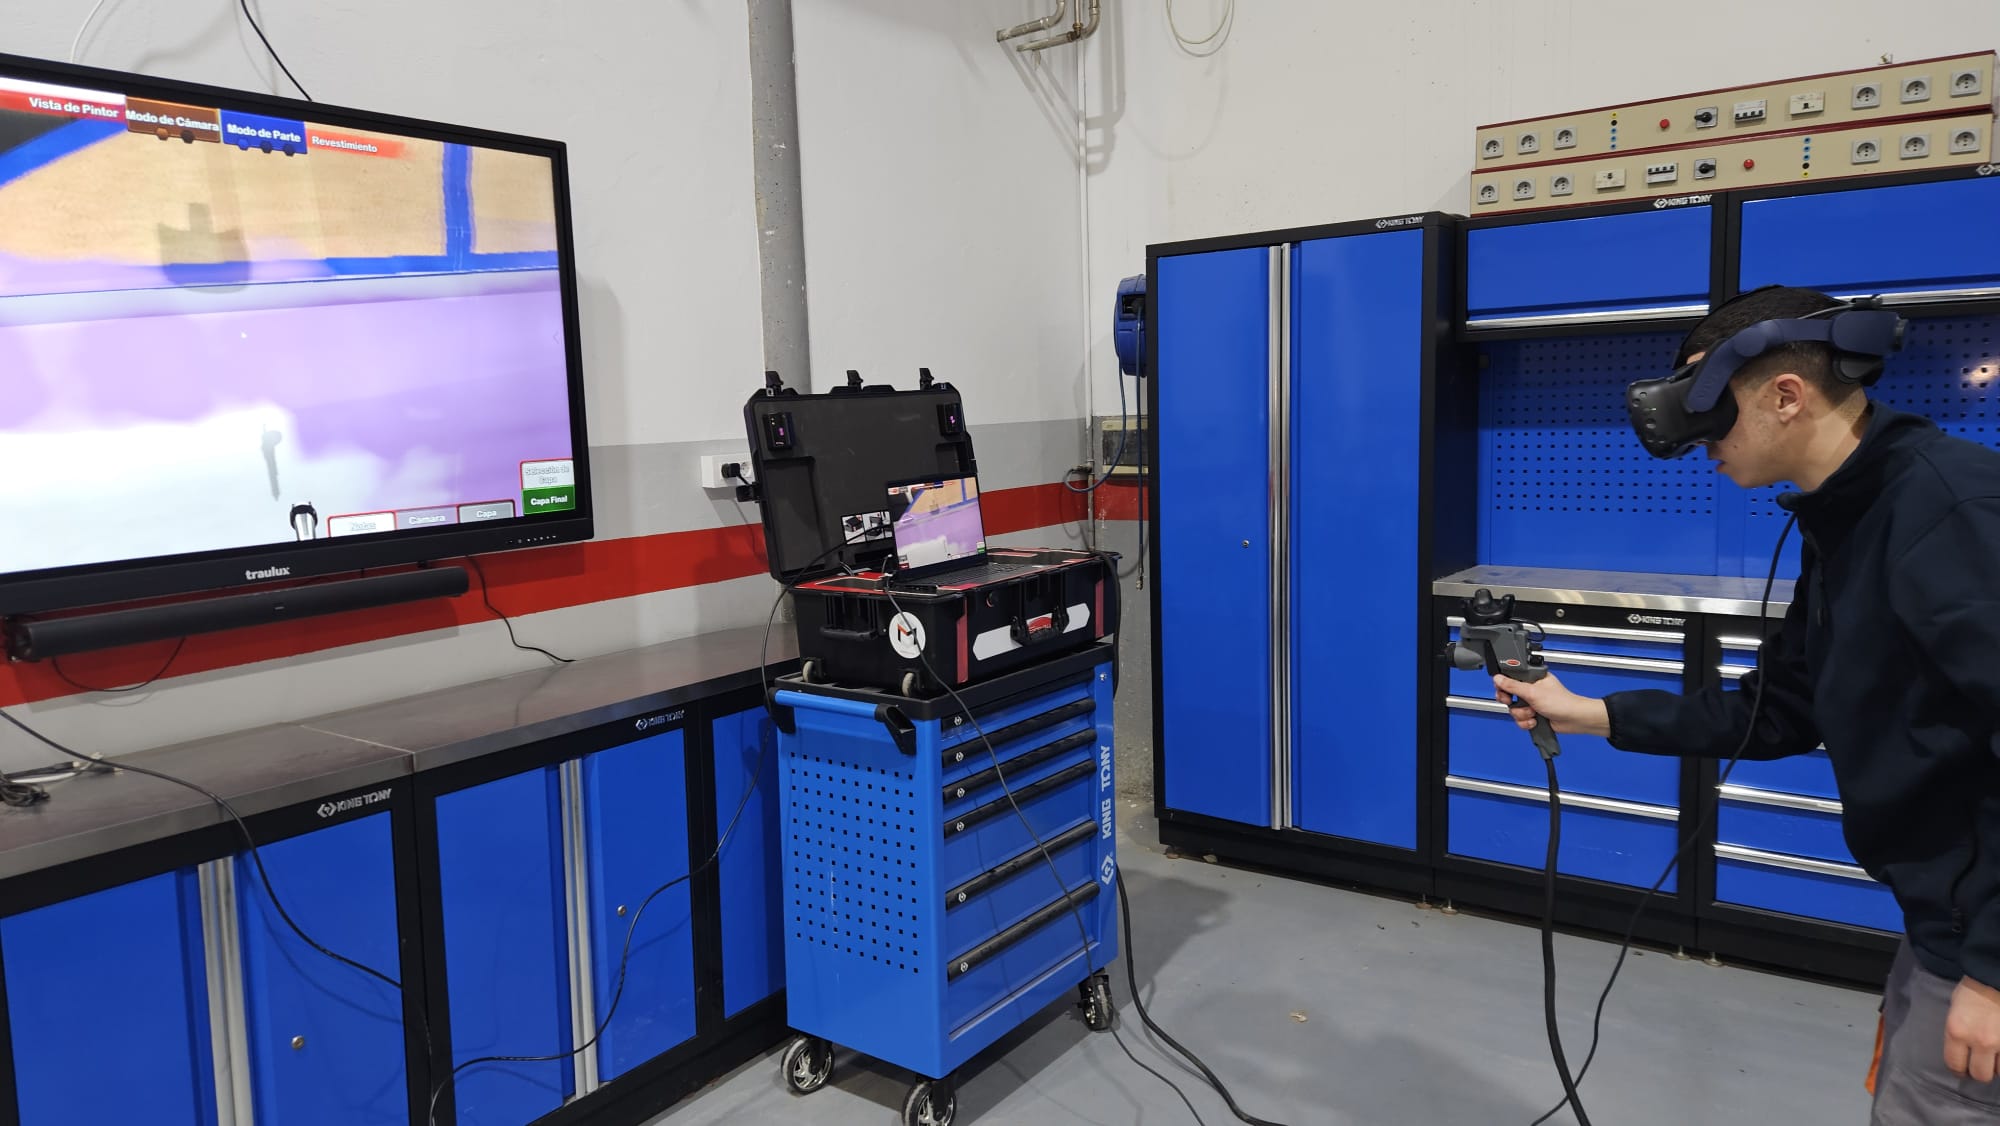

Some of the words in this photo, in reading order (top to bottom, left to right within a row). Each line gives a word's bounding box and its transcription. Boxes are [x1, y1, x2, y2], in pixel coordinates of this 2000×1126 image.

[28, 96, 62, 111] Vista
[64, 101, 80, 113] de
[82, 104, 119, 118] Pintor
[126, 110, 157, 123] Modo
[158, 114, 175, 126] de
[226, 123, 256, 137] Modo
[257, 128, 271, 138] de
[272, 130, 301, 143] Parte
[311, 136, 377, 152] Revestimiento
[1667, 197, 1689, 206] KING
[1689, 194, 1713, 204] TONY
[1388, 218, 1405, 226] KING
[530, 497, 550, 507] Capa
[550, 494, 568, 504] Final
[476, 509, 497, 519] Capa
[245, 566, 291, 580] traulux
[1641, 615, 1662, 625] KING
[1100, 745, 1111, 793] TONY
[337, 796, 362, 812] KING
[363, 788, 392, 804] TONY
[1102, 797, 1112, 841] KING
